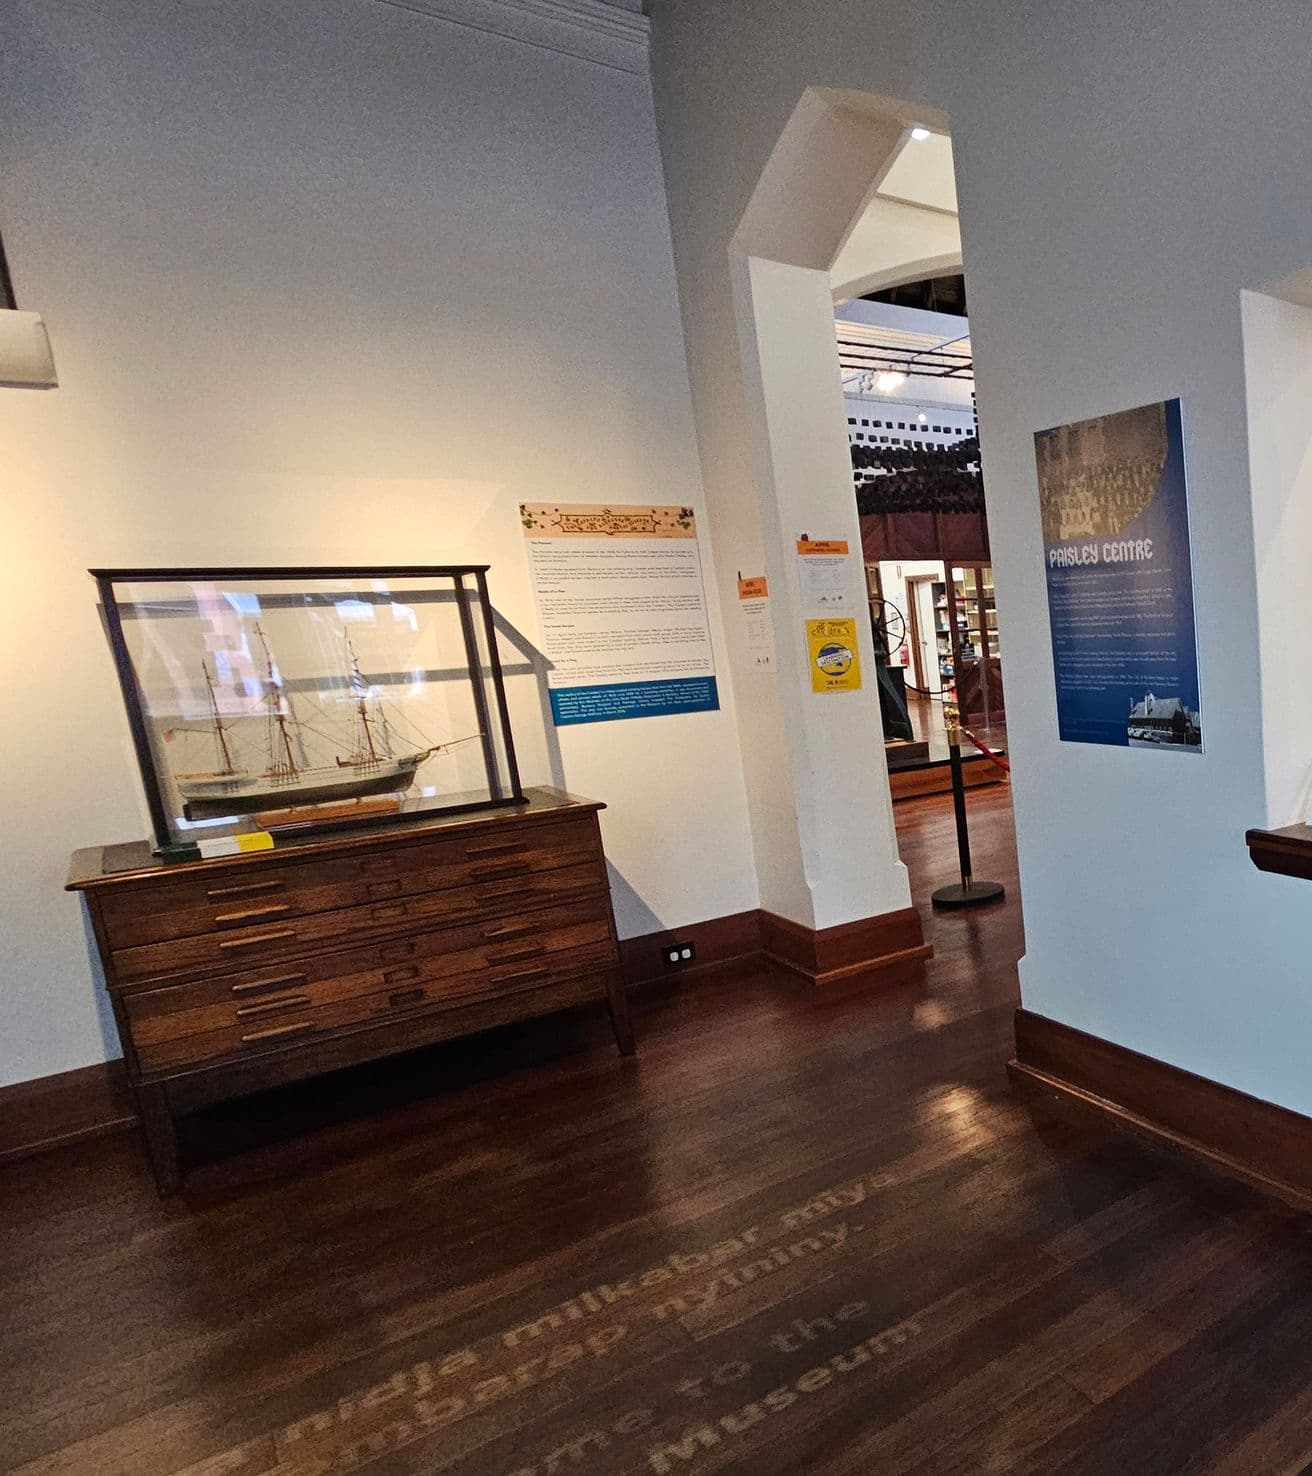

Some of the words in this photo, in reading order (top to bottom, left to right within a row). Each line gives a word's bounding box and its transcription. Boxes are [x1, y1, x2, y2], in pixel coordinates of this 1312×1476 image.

[1049, 544, 1098, 568] PAISLEY
[1103, 538, 1153, 563] CENTRE
[648, 1319, 922, 1474] Museum
[676, 1360, 753, 1399] to
[768, 1301, 869, 1353] the
